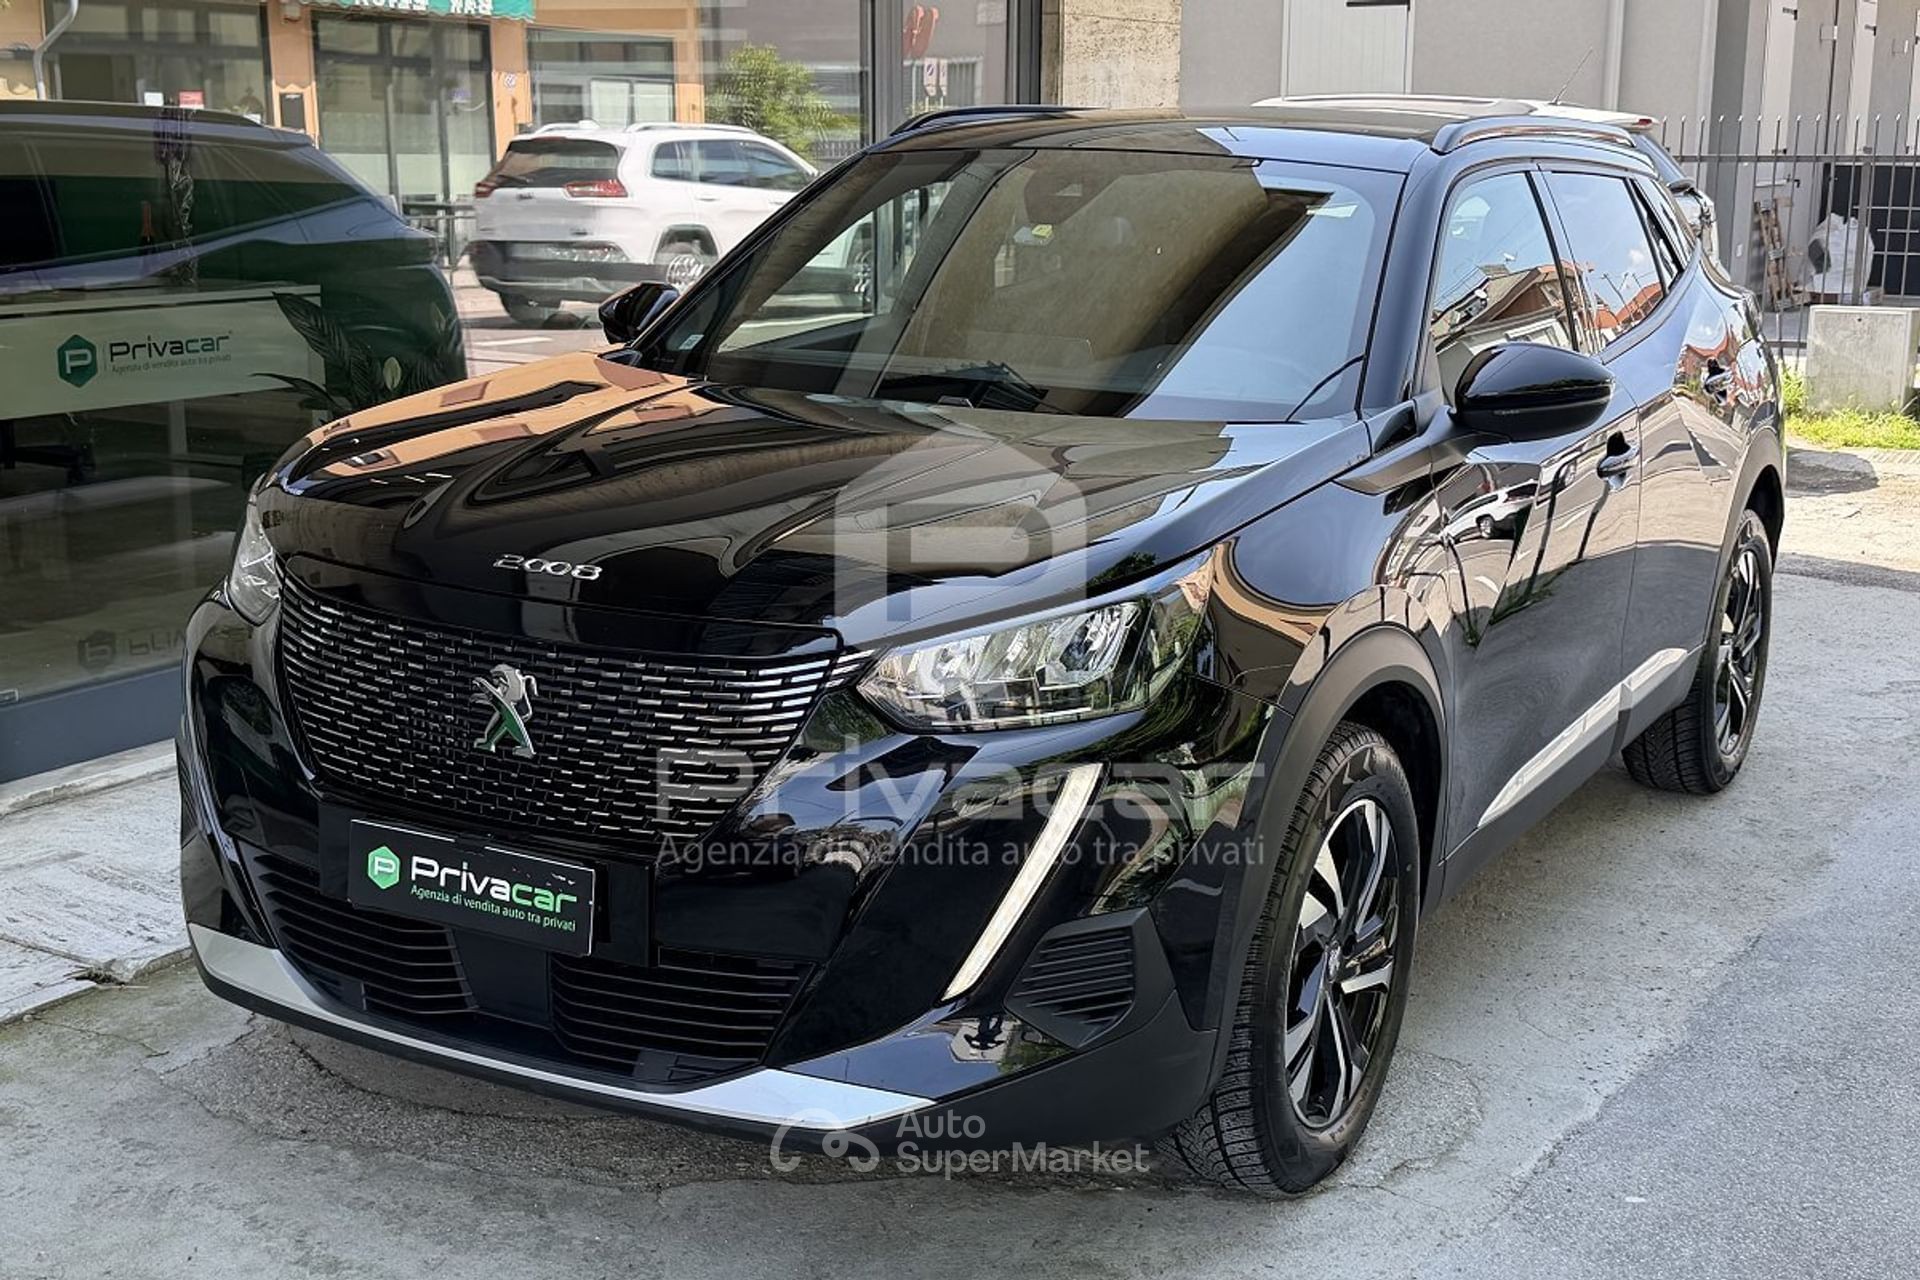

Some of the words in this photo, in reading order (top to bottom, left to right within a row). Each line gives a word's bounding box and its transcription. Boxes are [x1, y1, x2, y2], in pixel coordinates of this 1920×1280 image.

[109, 334, 229, 362] Privacar
[493, 554, 602, 580] 2008
[411, 856, 578, 913] Privacar
[410, 884, 450, 903] Agenzia
[452, 893, 463, 905] di
[463, 898, 501, 915] vendita
[502, 907, 526, 921] auto
[527, 911, 541, 924] tra
[543, 916, 576, 933] privati
